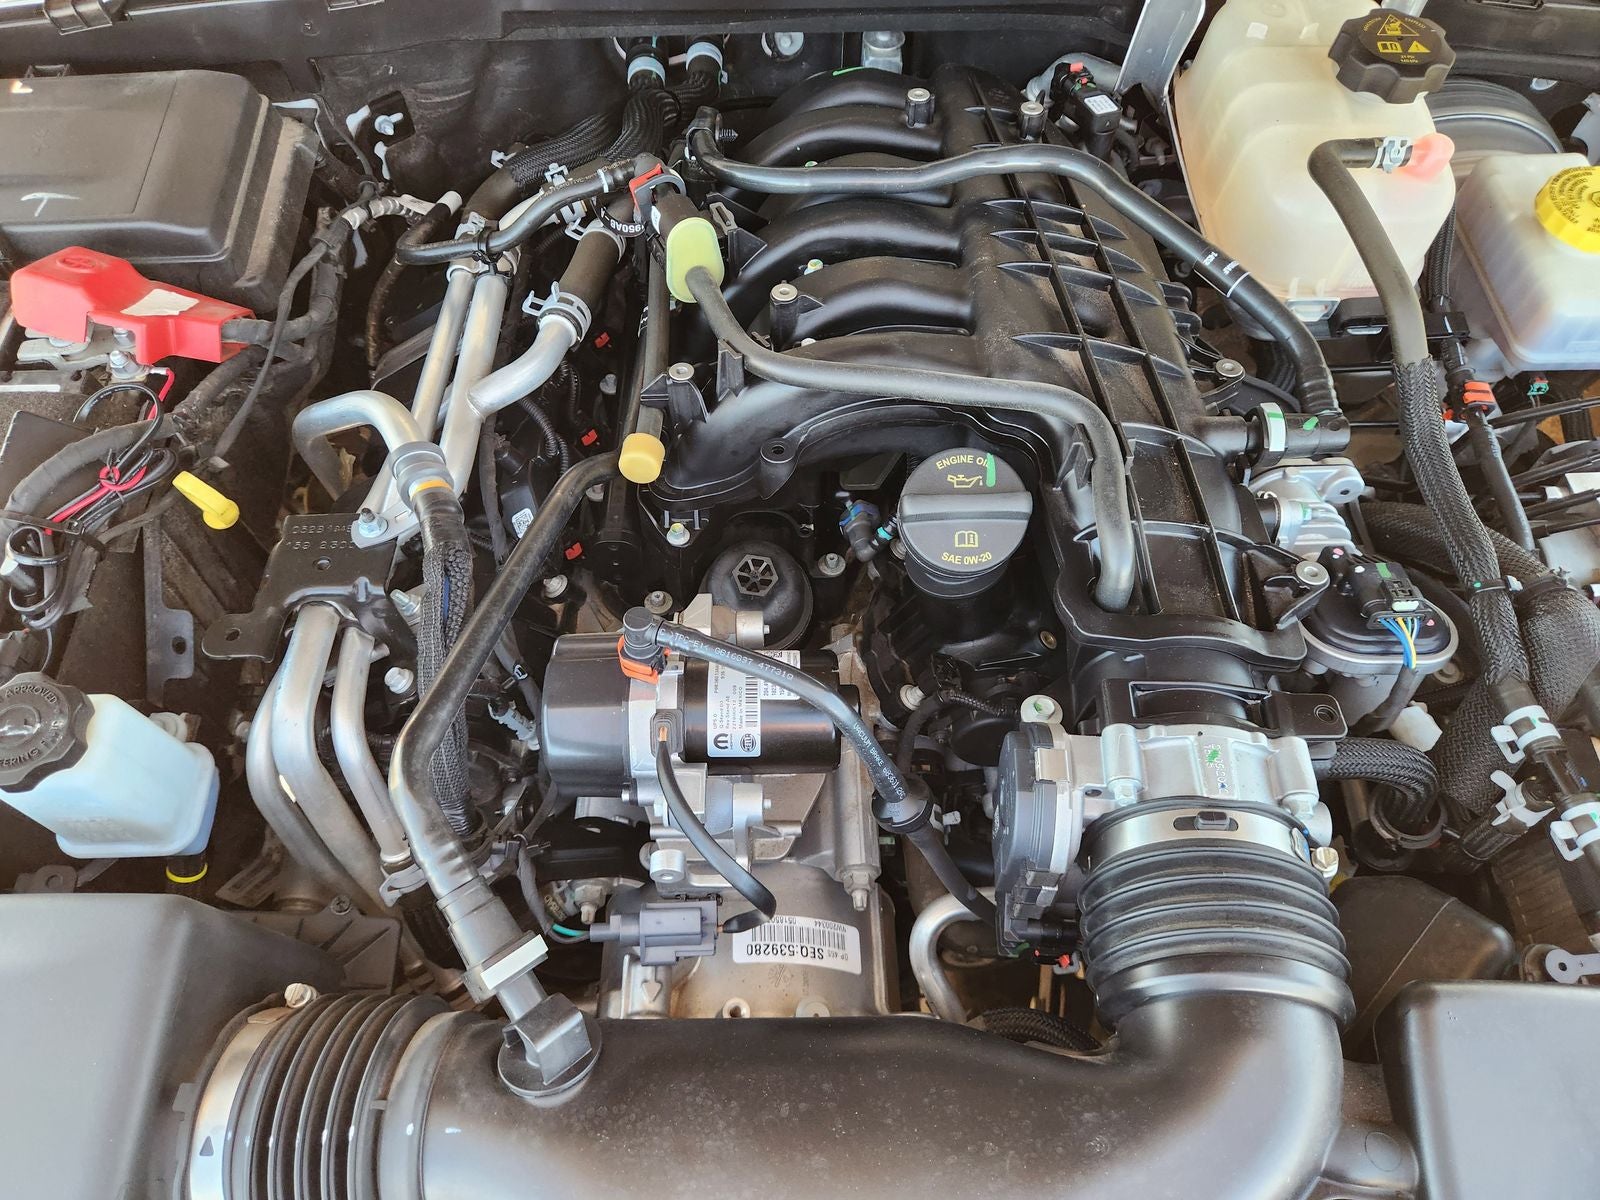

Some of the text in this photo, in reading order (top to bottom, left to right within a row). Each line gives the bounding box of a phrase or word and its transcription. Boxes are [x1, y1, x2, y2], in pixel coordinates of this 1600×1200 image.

[935, 454, 989, 471] ENGINE OI
[941, 551, 992, 565] SAE 0W-20
[746, 943, 824, 960] SEQ:539280
